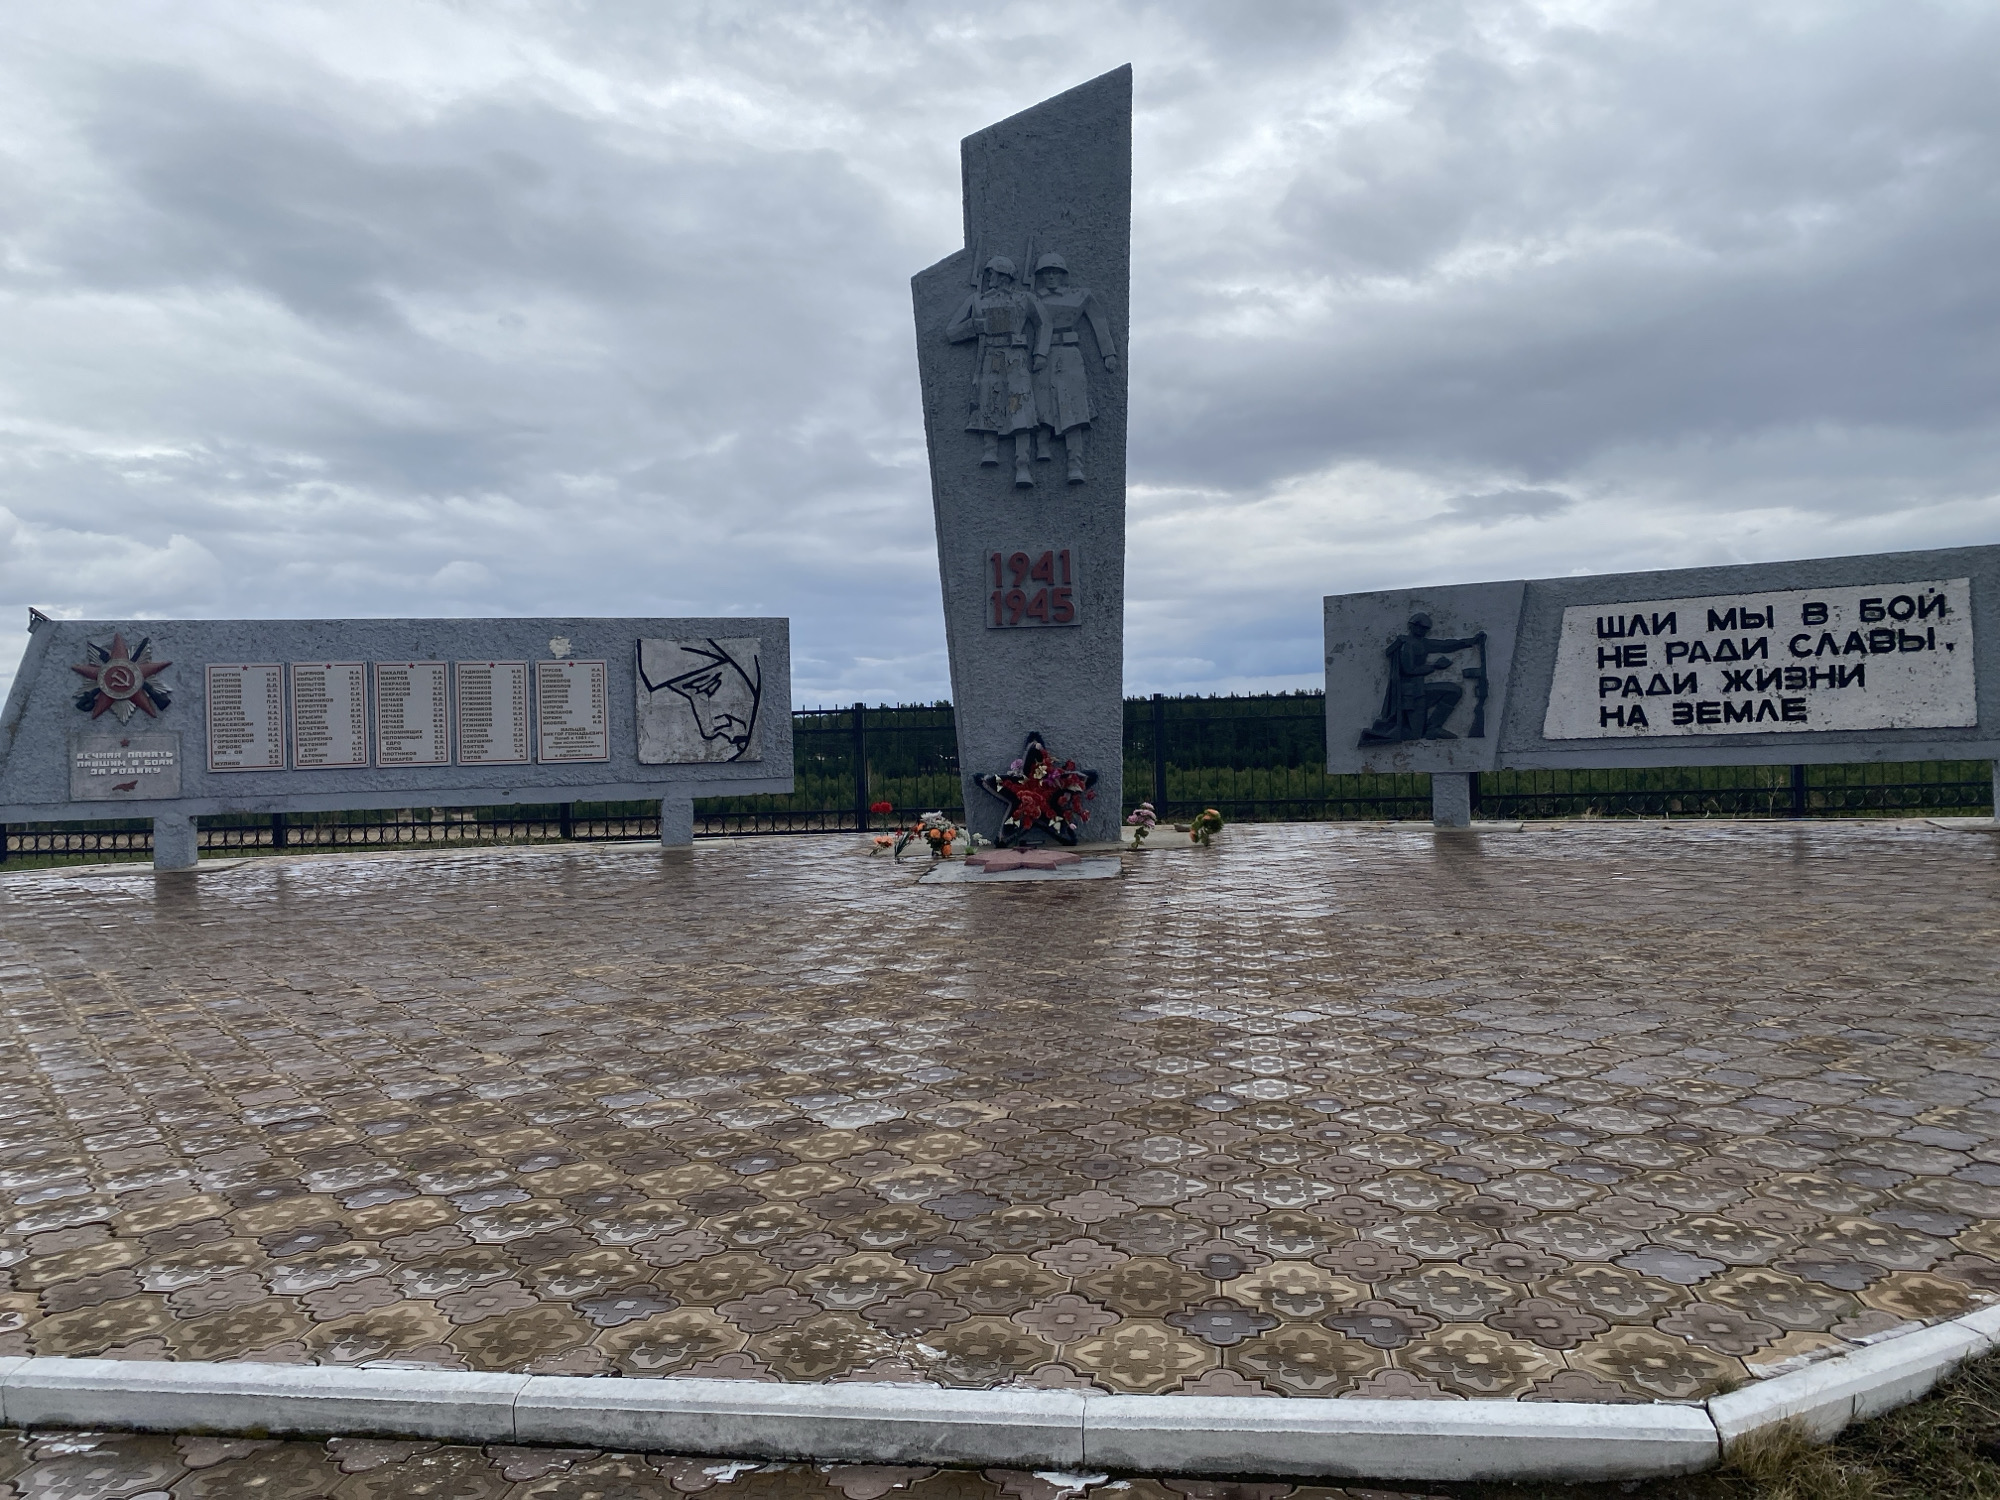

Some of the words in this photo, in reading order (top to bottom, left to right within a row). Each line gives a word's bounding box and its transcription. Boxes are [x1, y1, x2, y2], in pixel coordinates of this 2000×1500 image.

[991, 550, 1071, 588] 1941
[991, 588, 1074, 626] 1945
[1596, 612, 1678, 638] ШЛИ
[1706, 606, 1774, 631] МЫ
[1802, 602, 1829, 626] В
[1860, 588, 1947, 622] БОЙ
[1598, 644, 1648, 669] НЕ
[1666, 636, 1769, 665] РАДИ
[1599, 672, 1698, 698] РАДИ
[1721, 664, 1866, 694] ЖИЗНИ
[1600, 704, 1649, 728] НА
[1672, 698, 1808, 726] ЗЕМЛЕ
